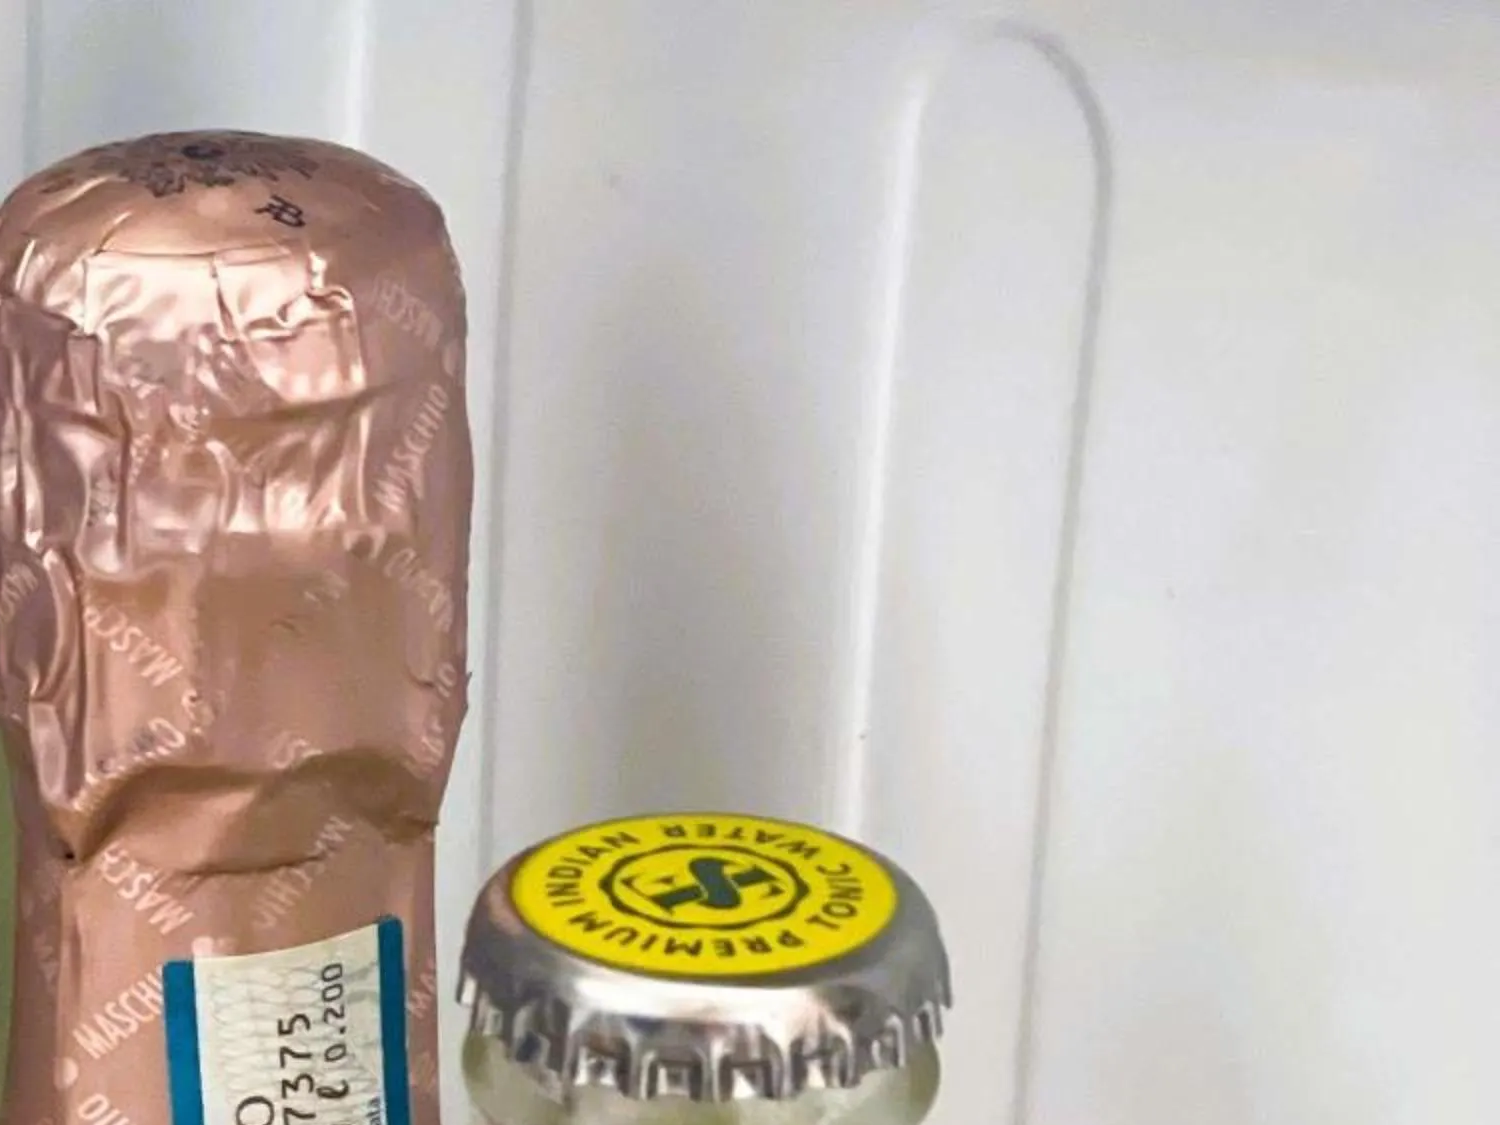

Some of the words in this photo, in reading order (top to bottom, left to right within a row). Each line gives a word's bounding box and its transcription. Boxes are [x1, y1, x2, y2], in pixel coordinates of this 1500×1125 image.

[545, 829, 641, 908] INDIAN
[660, 822, 821, 861] WATER
[805, 861, 866, 931] TONIC
[568, 909, 807, 958] PREMIUM
[72, 962, 164, 1060] MASCHI
[320, 962, 349, 1063] 0.200
